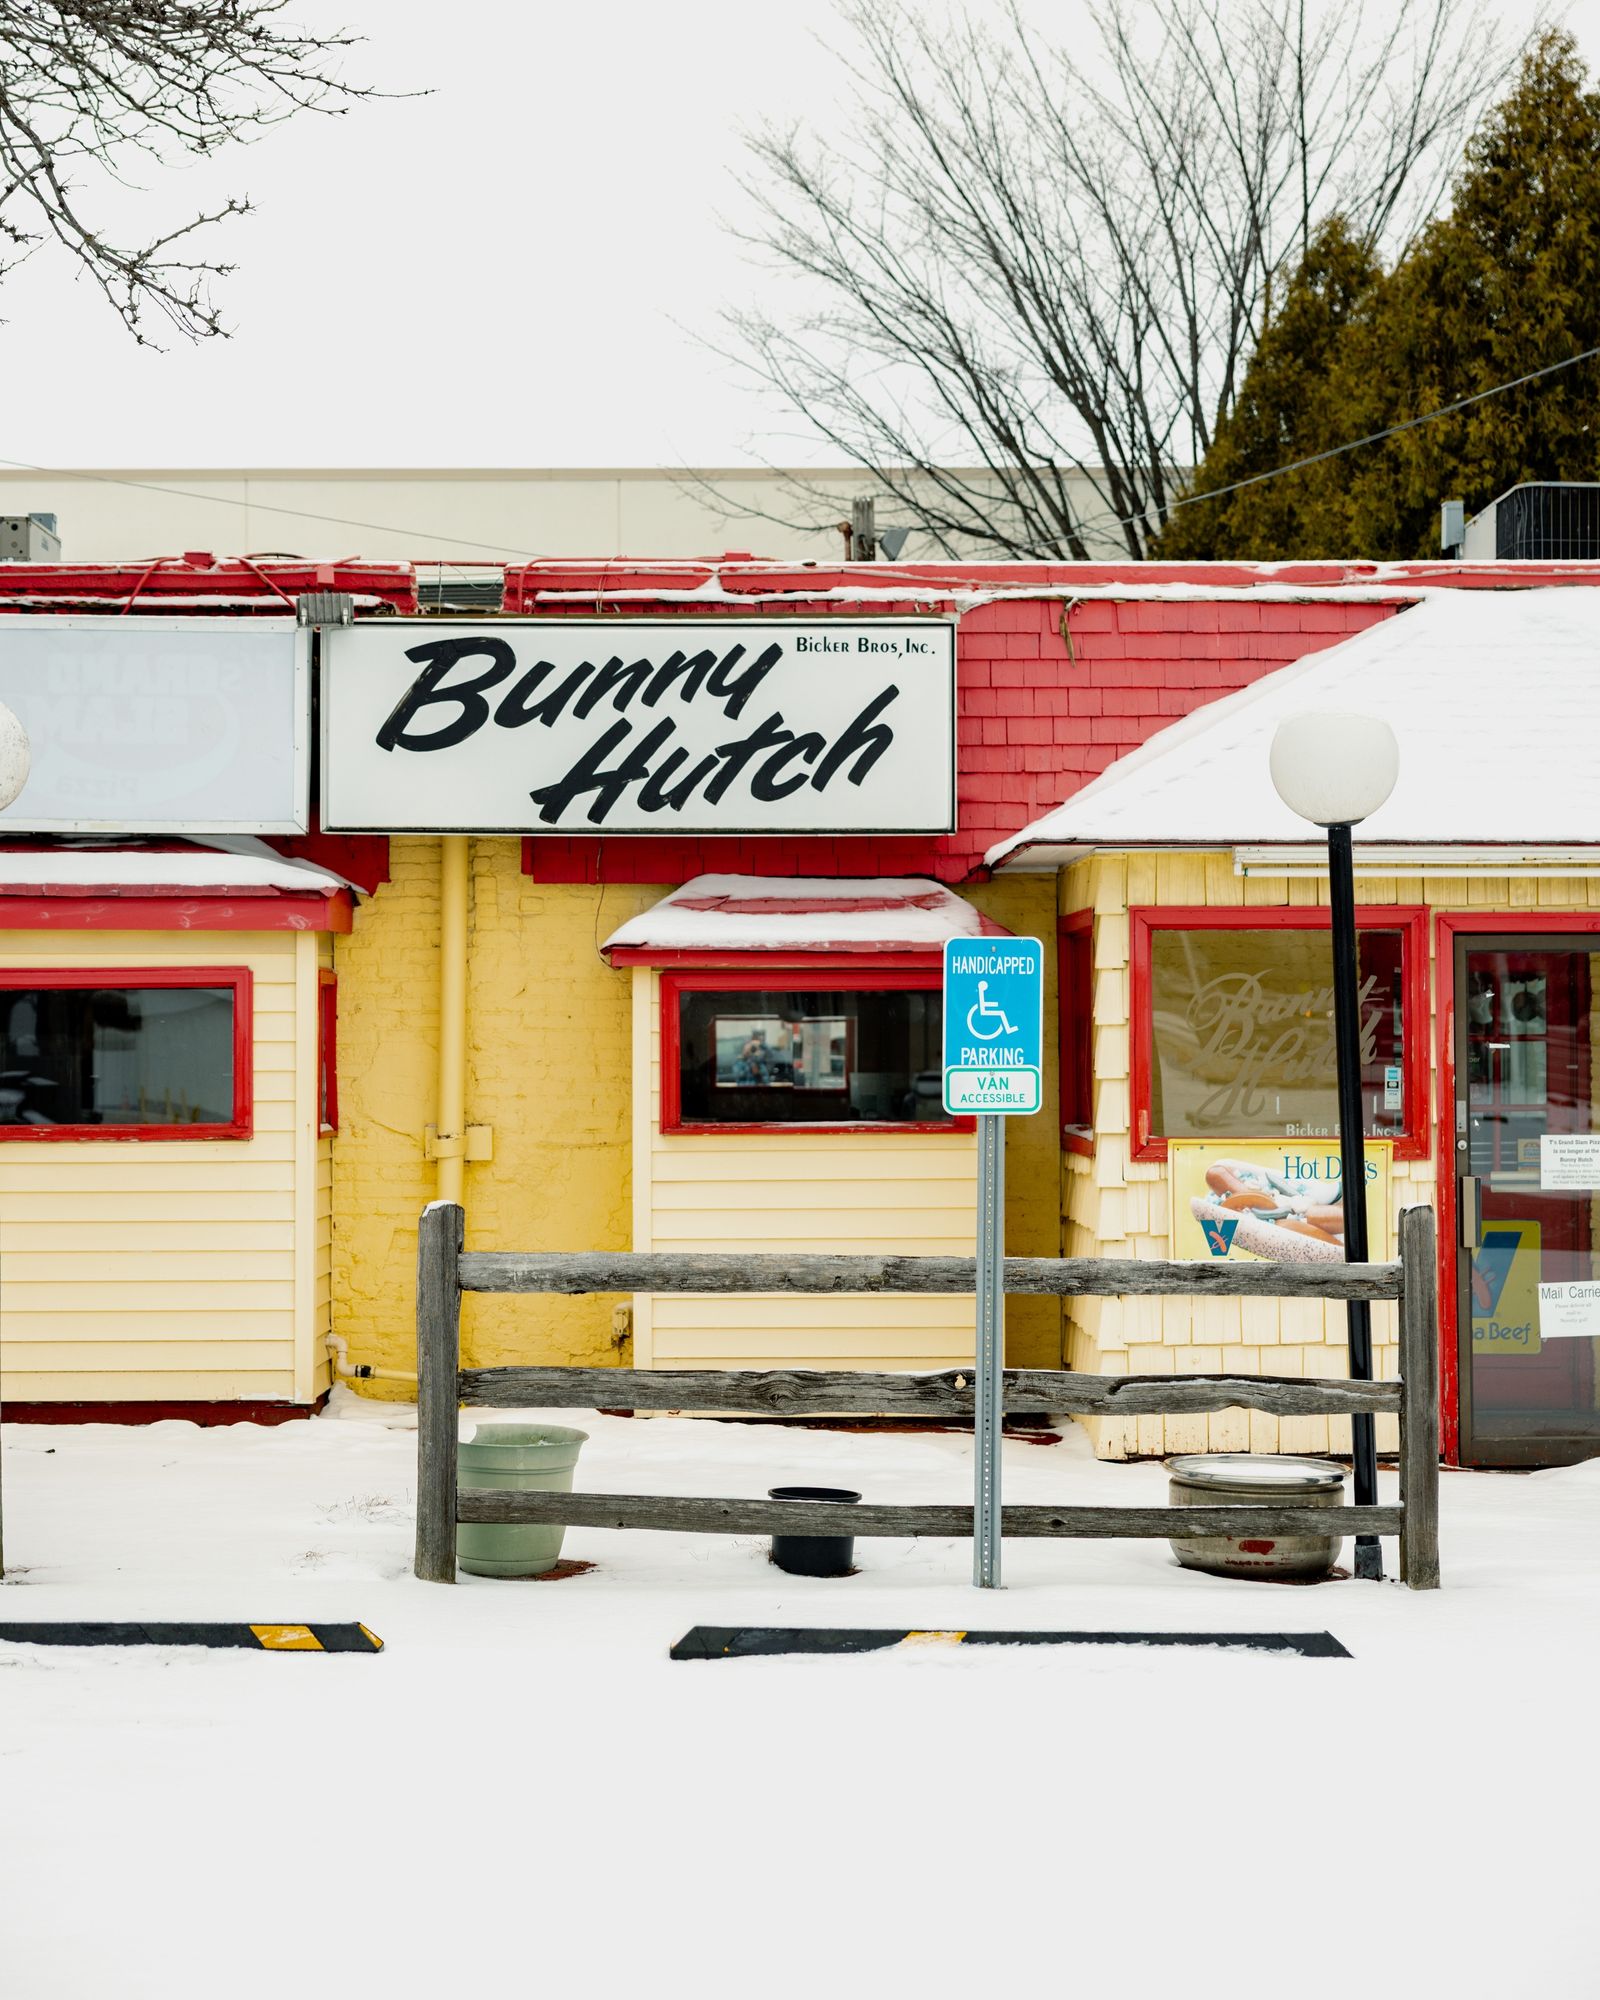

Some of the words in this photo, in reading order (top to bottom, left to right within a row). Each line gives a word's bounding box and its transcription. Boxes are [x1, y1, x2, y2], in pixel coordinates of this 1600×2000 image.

[375, 636, 784, 753] Bunny
[530, 684, 900, 825] Hutch
[952, 956, 1035, 975] HANDICAPPED
[961, 1047, 1024, 1065] PARKING
[1195, 1011, 1383, 1129] Huth
[977, 1077, 1009, 1090] VAN
[960, 1093, 1025, 1103] ACCESSIBLE
[1284, 1156, 1321, 1180] Hot
[1325, 1156, 1378, 1184] Ds
[1541, 1287, 1563, 1299] Mail
[1489, 1322, 1531, 1345] Beef
